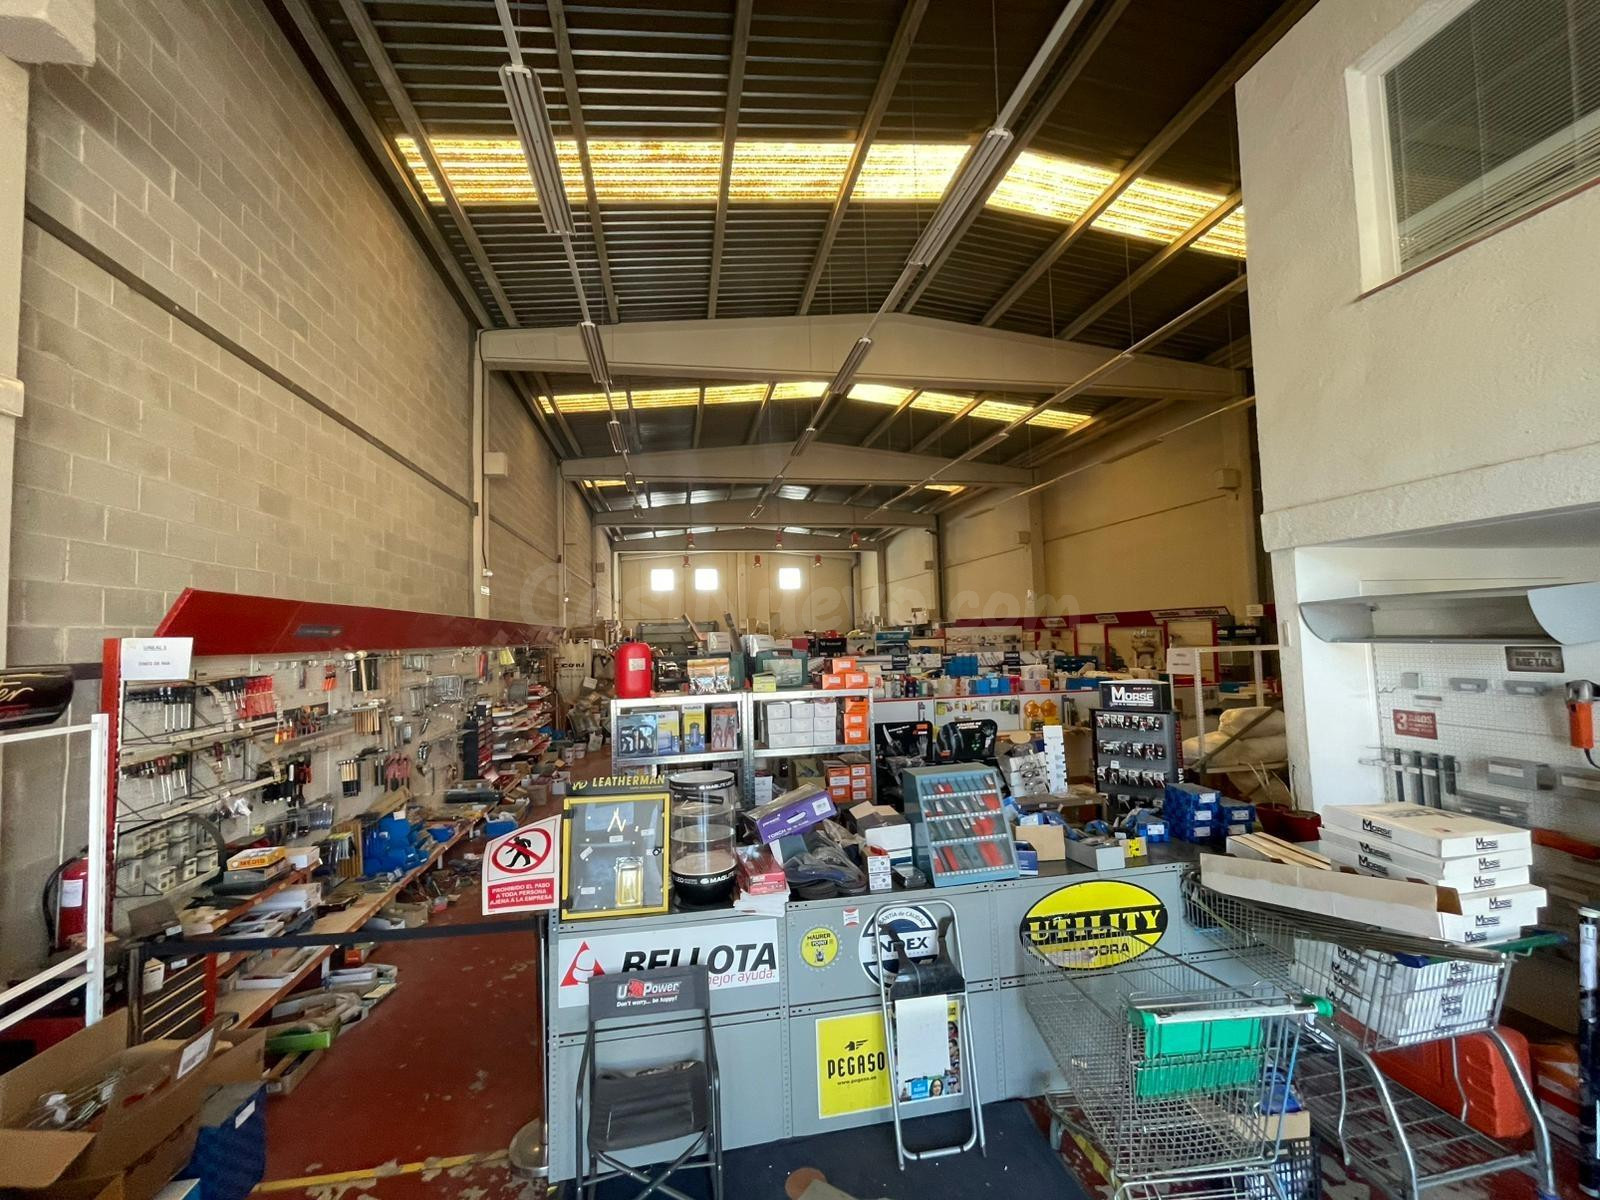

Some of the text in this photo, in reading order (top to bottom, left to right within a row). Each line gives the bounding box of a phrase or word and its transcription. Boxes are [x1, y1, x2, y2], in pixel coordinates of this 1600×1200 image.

[1515, 657, 1553, 668] METAL
[1111, 686, 1154, 702] MORSE
[1396, 713, 1408, 730] 3
[592, 775, 665, 787] LEATHERMAN
[1362, 818, 1393, 838] MORSE
[1476, 838, 1498, 850] MORSE
[1479, 857, 1501, 870] MORSE
[491, 885, 525, 894] PROHIBIDO
[524, 894, 552, 902] EMPRESA
[1489, 896, 1513, 909] MORSE
[1029, 909, 1161, 942] UTILITY
[1475, 914, 1500, 926] MORSE
[807, 932, 831, 940] MAURER
[827, 1051, 885, 1079] PEGASO
